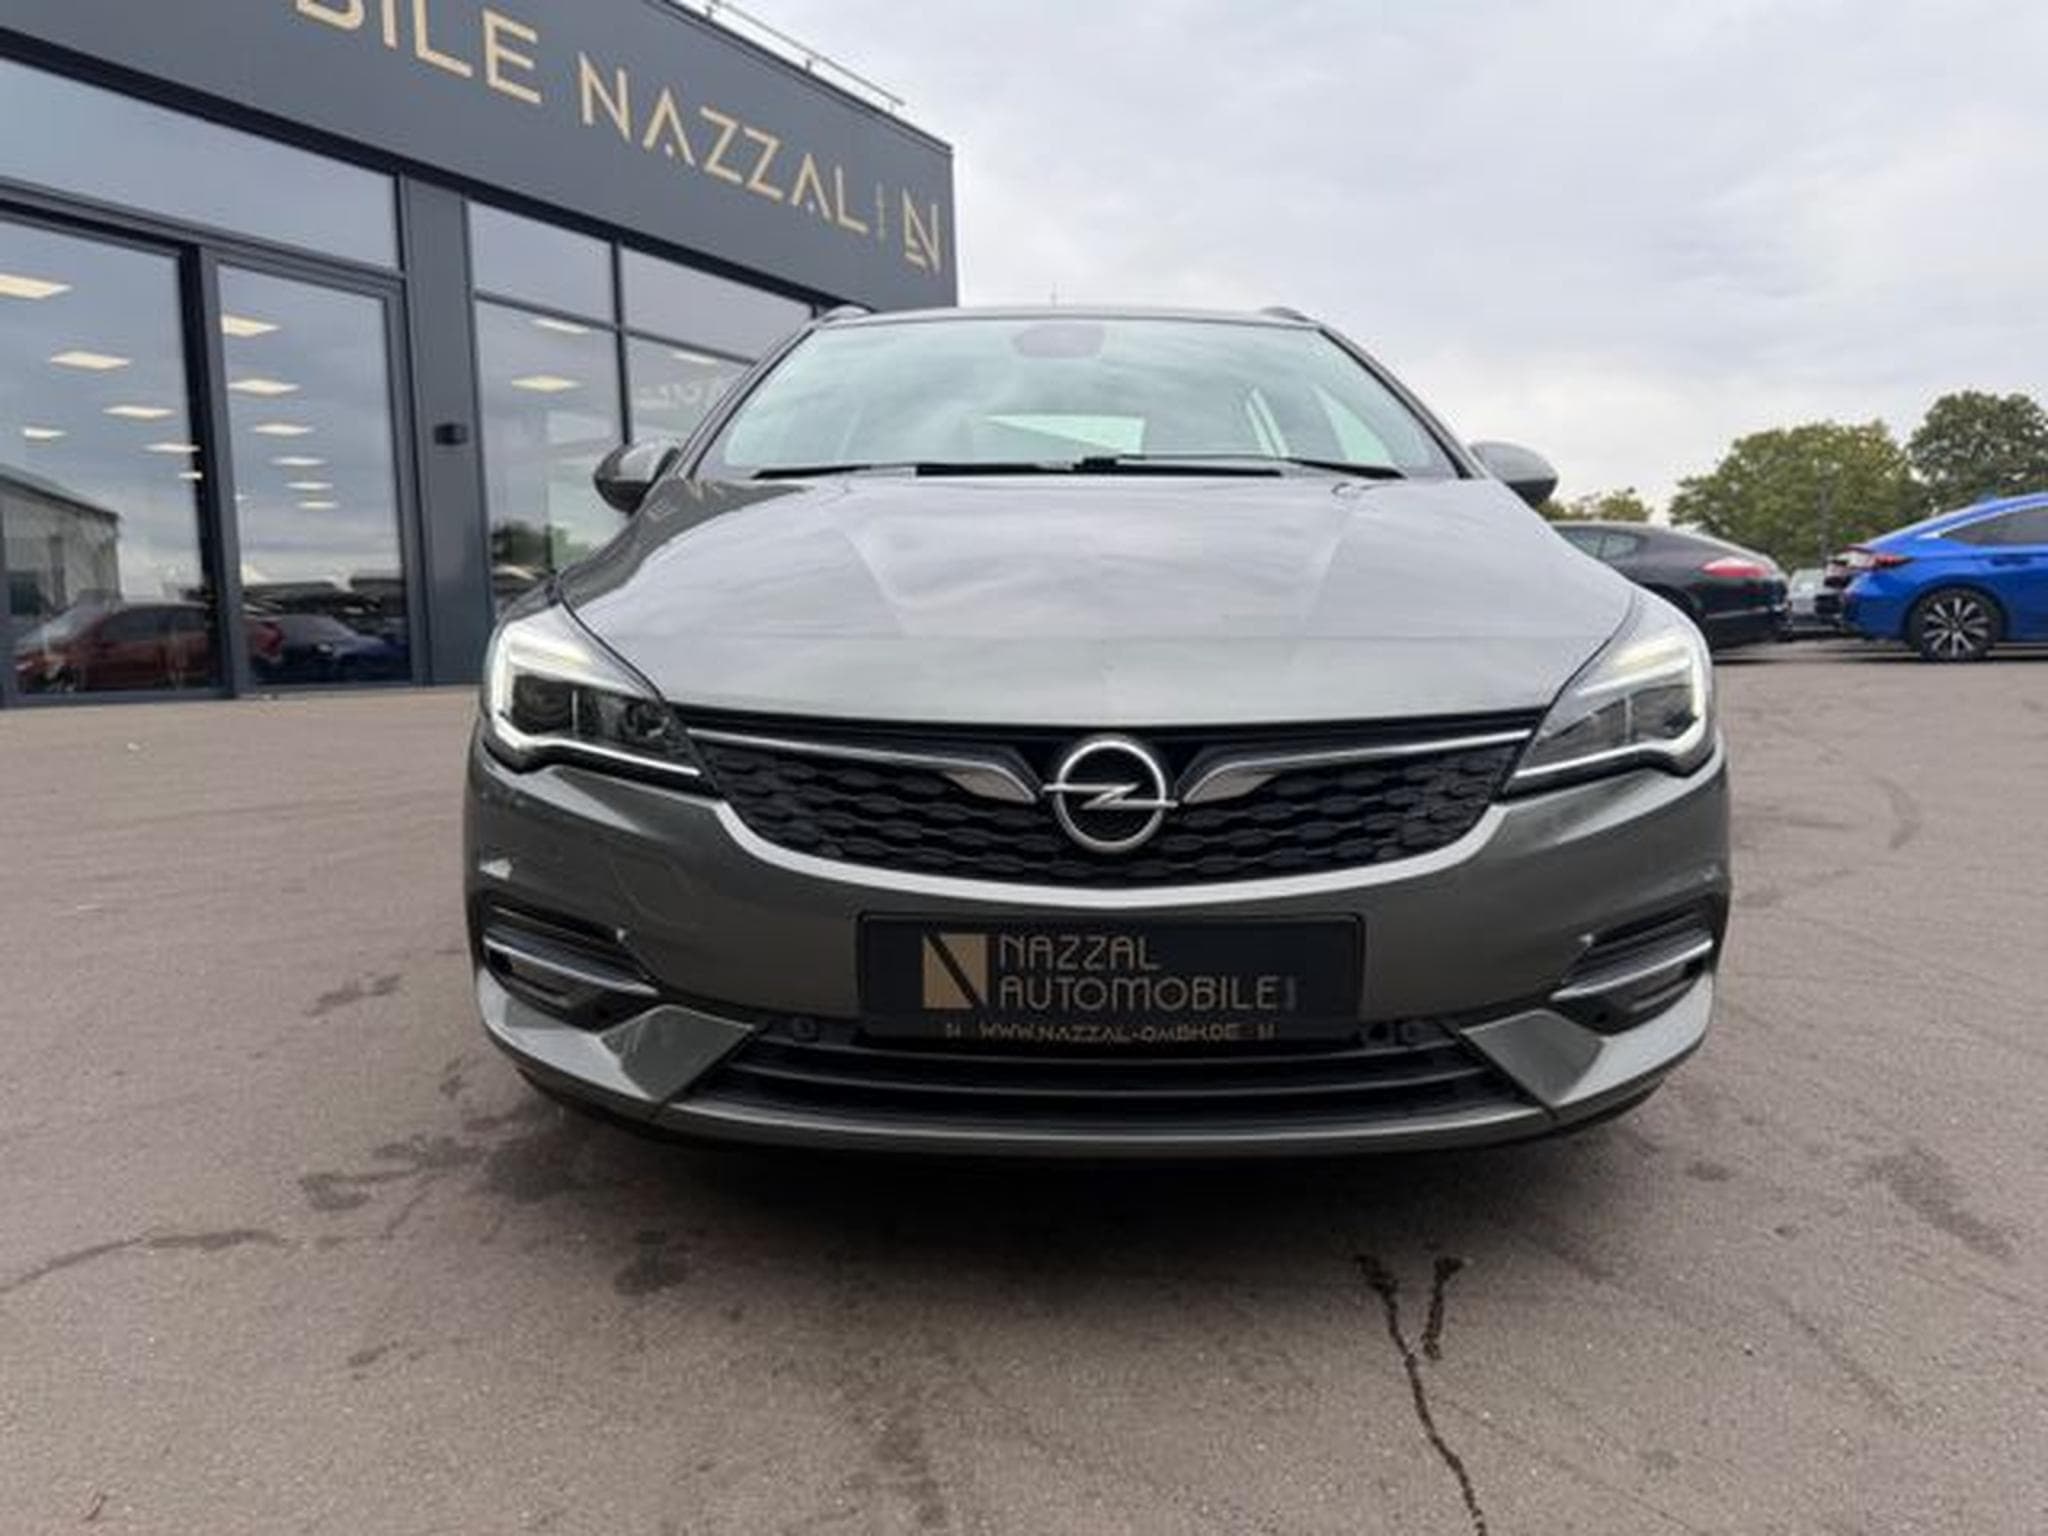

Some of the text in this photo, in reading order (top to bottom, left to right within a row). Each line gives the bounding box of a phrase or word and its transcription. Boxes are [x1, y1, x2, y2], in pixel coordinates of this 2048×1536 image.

[297, 0, 541, 104] ILE
[578, 51, 869, 234] NAZZAL
[998, 934, 1160, 971] NAZZAL
[998, 975, 1279, 1011] AUTOMOBILE
